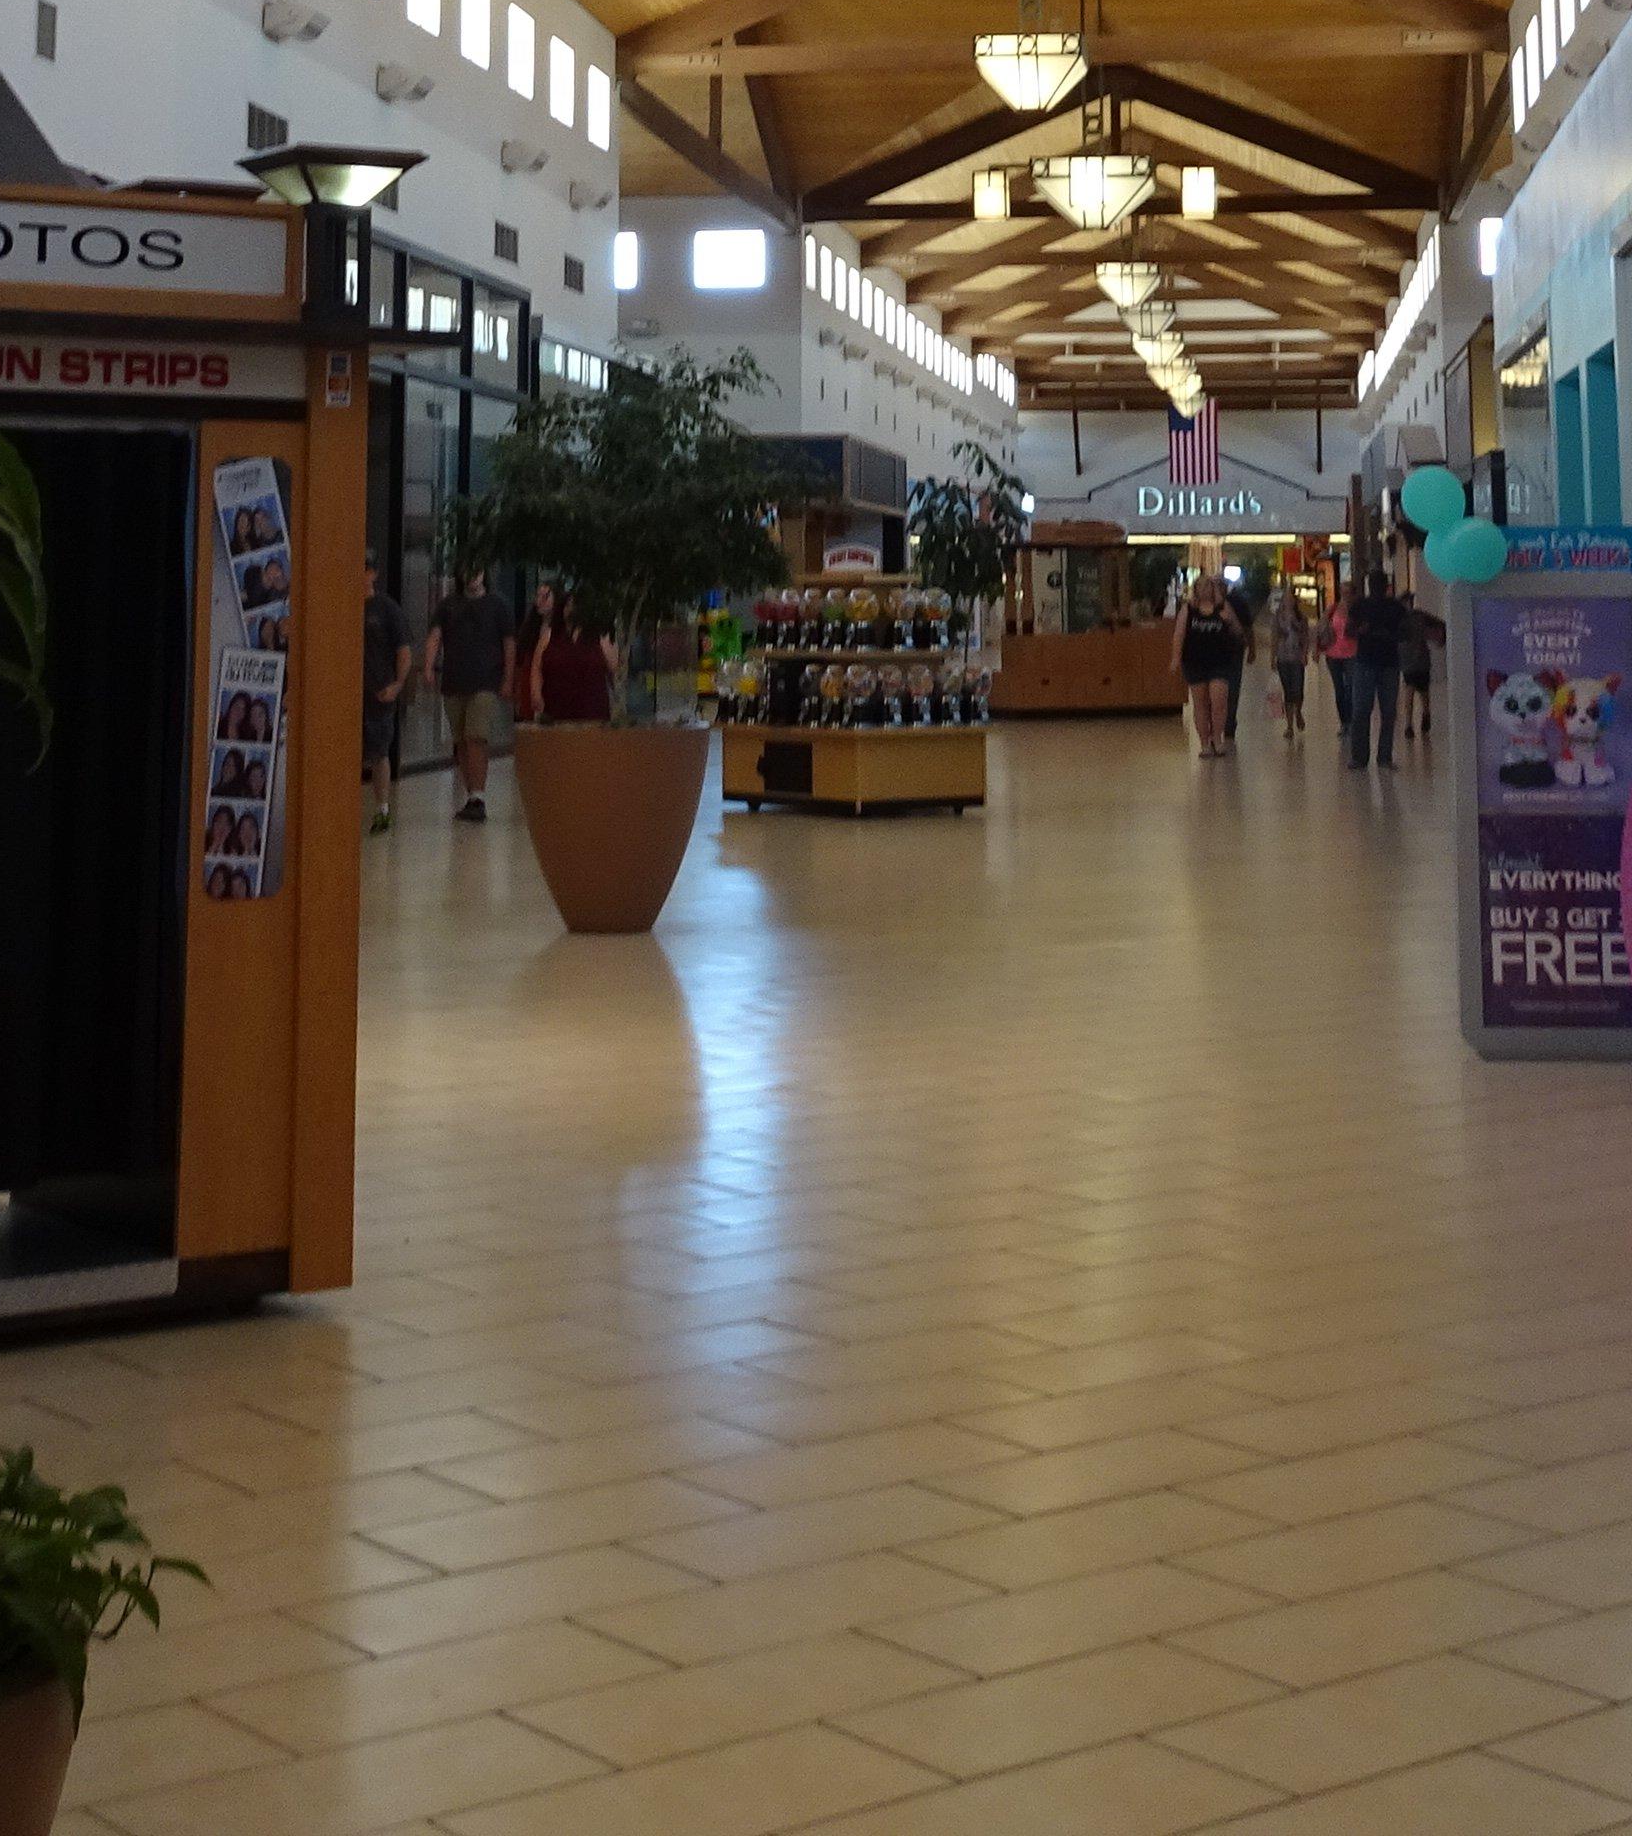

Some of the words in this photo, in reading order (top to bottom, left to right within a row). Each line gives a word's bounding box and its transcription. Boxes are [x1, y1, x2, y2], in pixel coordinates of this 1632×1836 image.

[59, 349, 230, 388] STRIPS
[1137, 485, 1263, 517] Dillard's
[1522, 633, 1581, 649] EVENT
[1490, 906, 1538, 930] BUY
[1545, 906, 1560, 929] 3
[1566, 906, 1613, 929] GET
[1490, 930, 1632, 986] FREE
